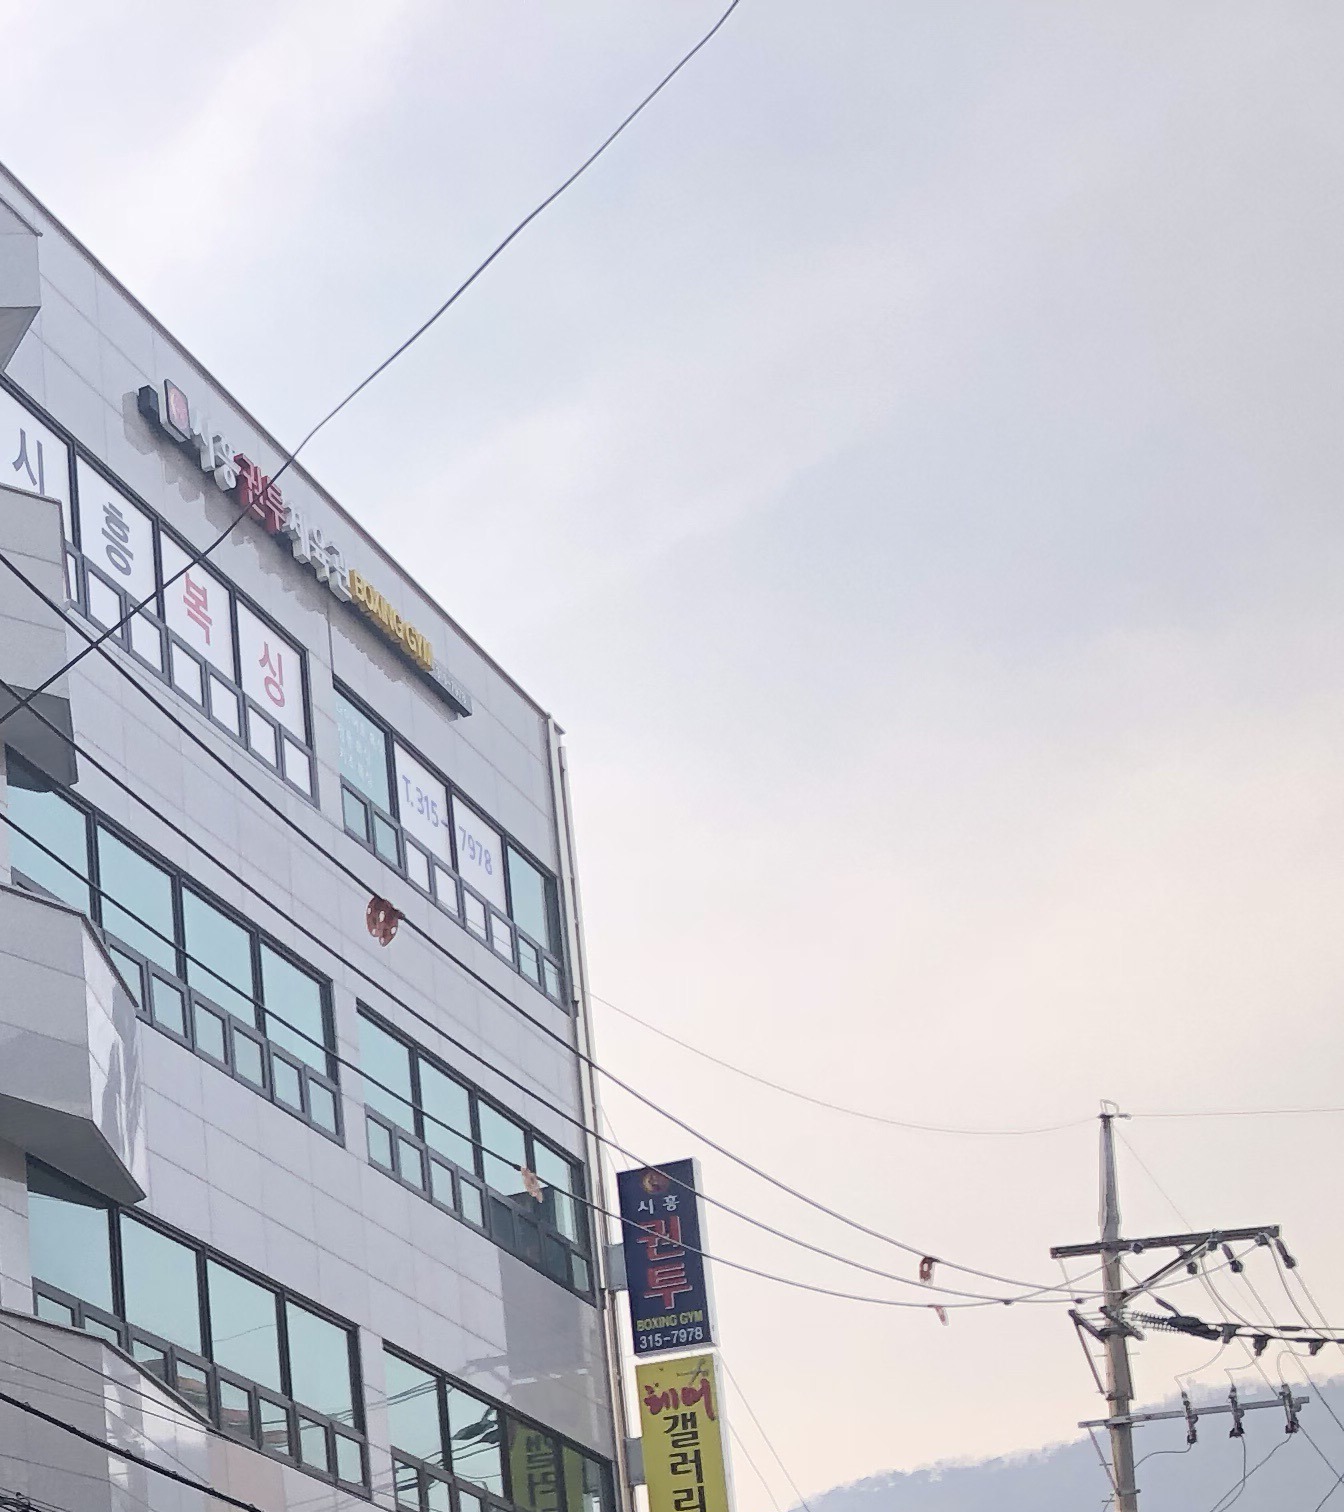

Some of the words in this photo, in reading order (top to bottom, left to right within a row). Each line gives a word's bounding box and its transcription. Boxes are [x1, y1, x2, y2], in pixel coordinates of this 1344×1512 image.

[637, 1194, 680, 1215] 시흥
[636, 1214, 694, 1310] 권투
[636, 1315, 678, 1333] BOXING
[679, 1309, 704, 1325] GYM
[639, 1326, 704, 1350] 315-7978
[643, 1377, 717, 1422] 헤어
